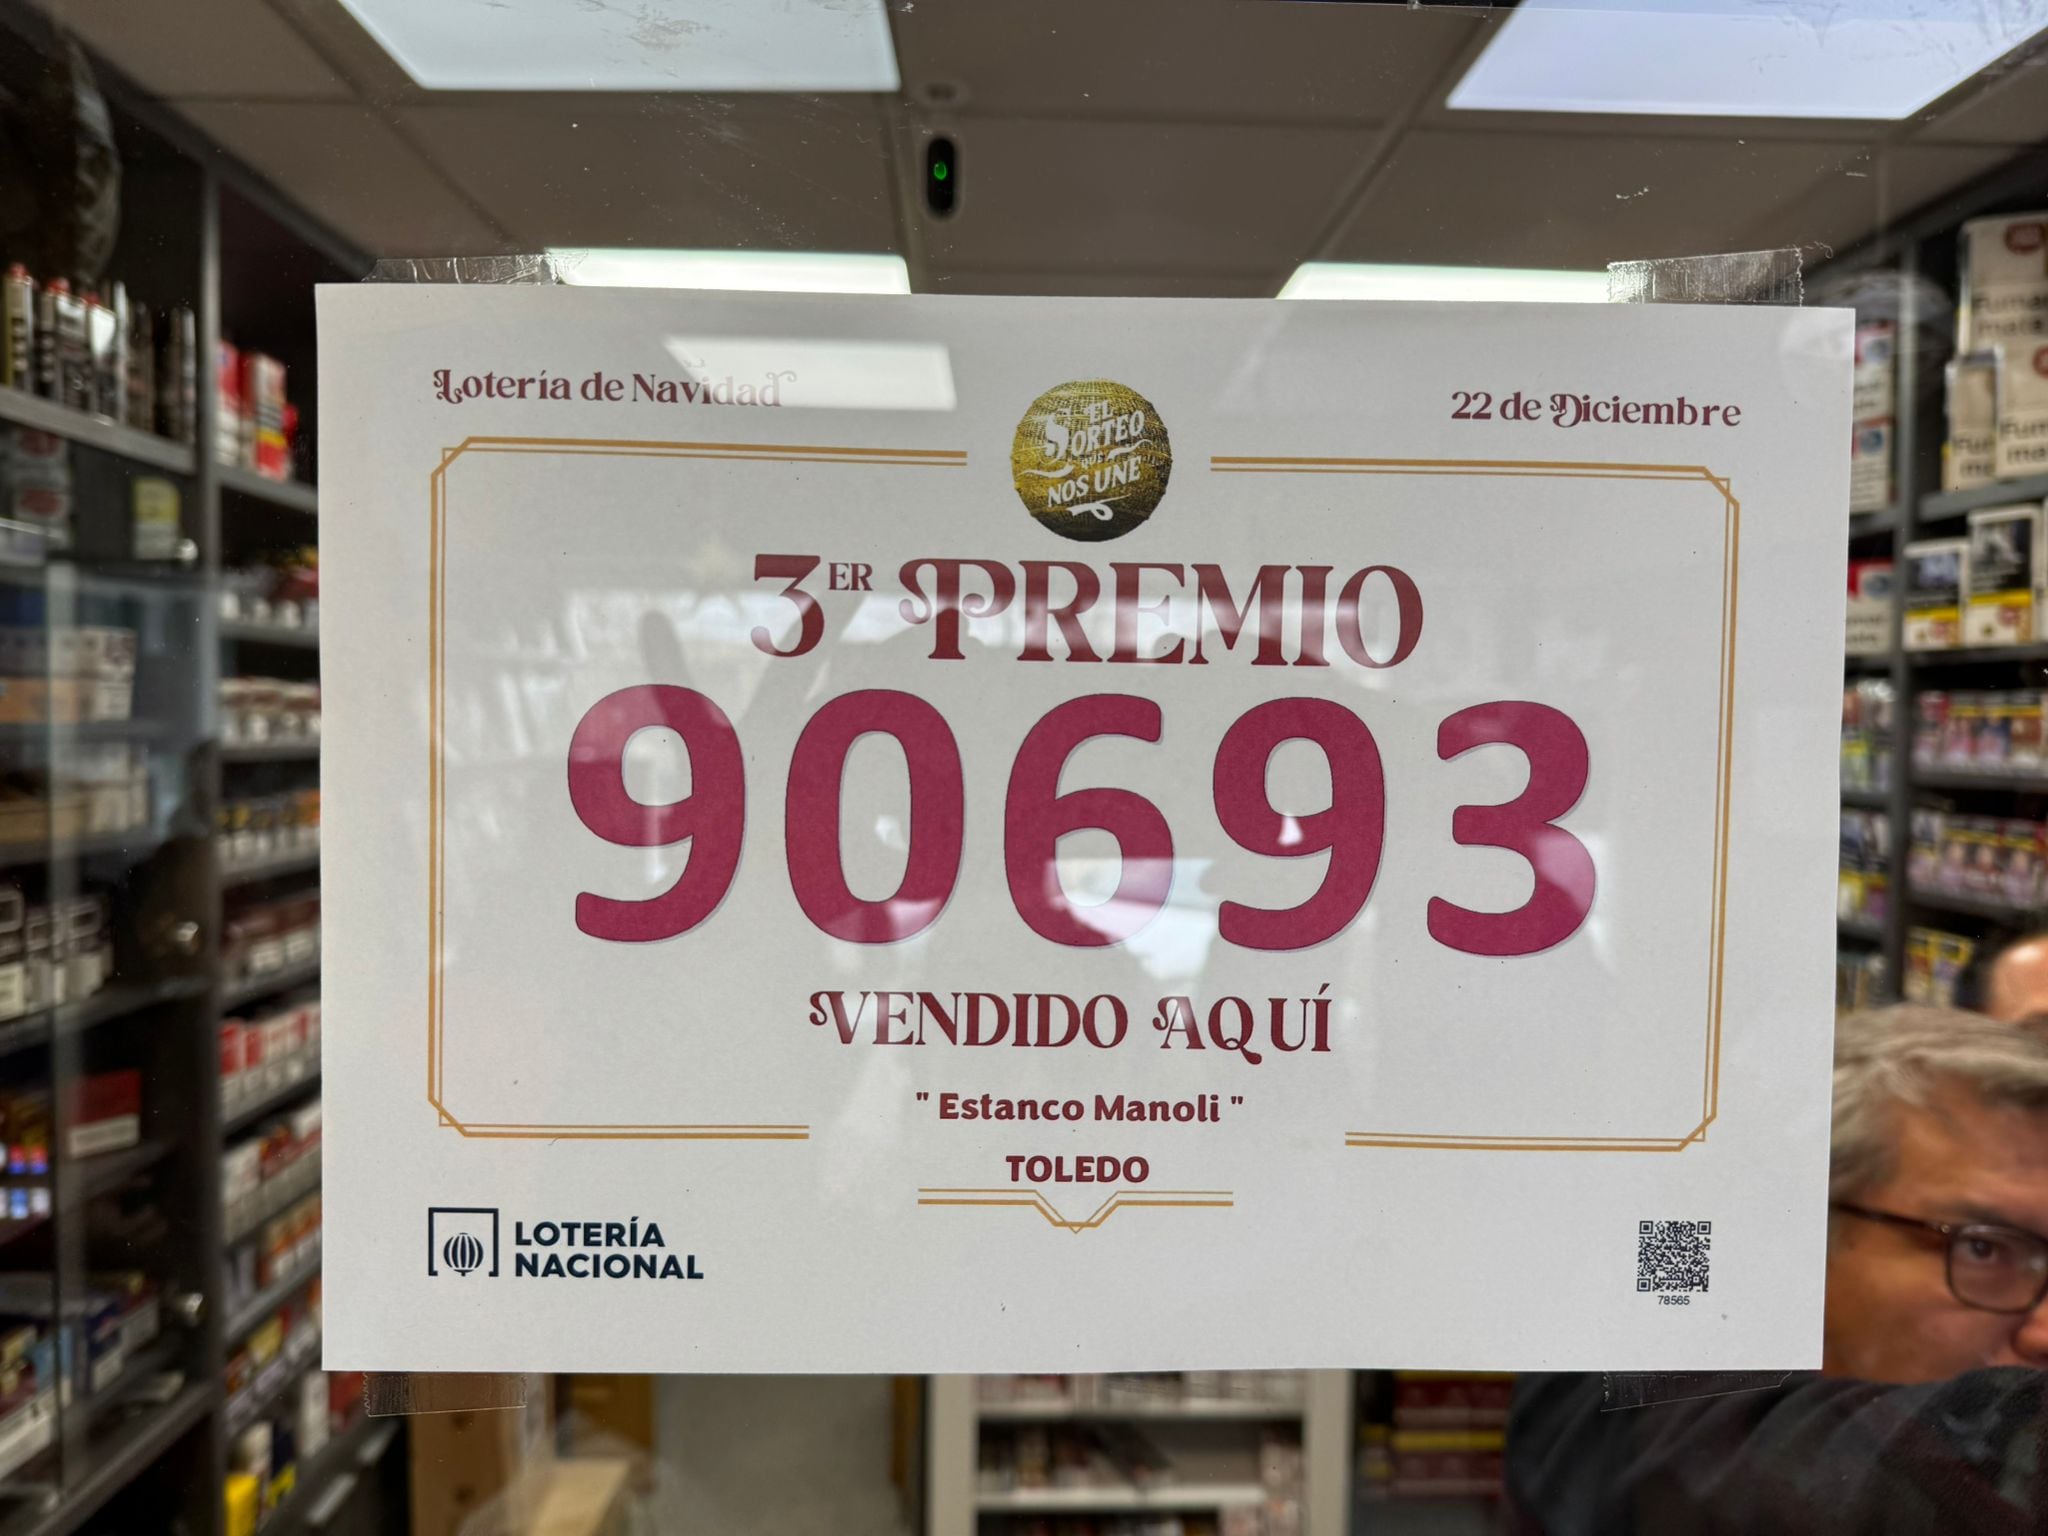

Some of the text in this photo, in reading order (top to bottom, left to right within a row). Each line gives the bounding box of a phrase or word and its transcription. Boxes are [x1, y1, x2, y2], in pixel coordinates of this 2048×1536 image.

[433, 369, 798, 407] Lotería de Navidad
[1086, 400, 1113, 425] EL
[1450, 391, 1742, 429] 22 de Diciembre
[1047, 456, 1142, 508] NOS UNE
[898, 557, 1424, 669] PREMIO
[567, 684, 1597, 956] 90693
[809, 982, 1333, 1066] VENDIDO AQUÍ
[939, 1092, 1085, 1122] Estanco
[1093, 1093, 1221, 1123] Manoli
[1005, 1154, 1150, 1184] TOLEDO
[514, 1215, 666, 1248] LOTERÍA
[514, 1252, 705, 1280] NACIONAL
[1657, 1294, 1691, 1306] 78565
